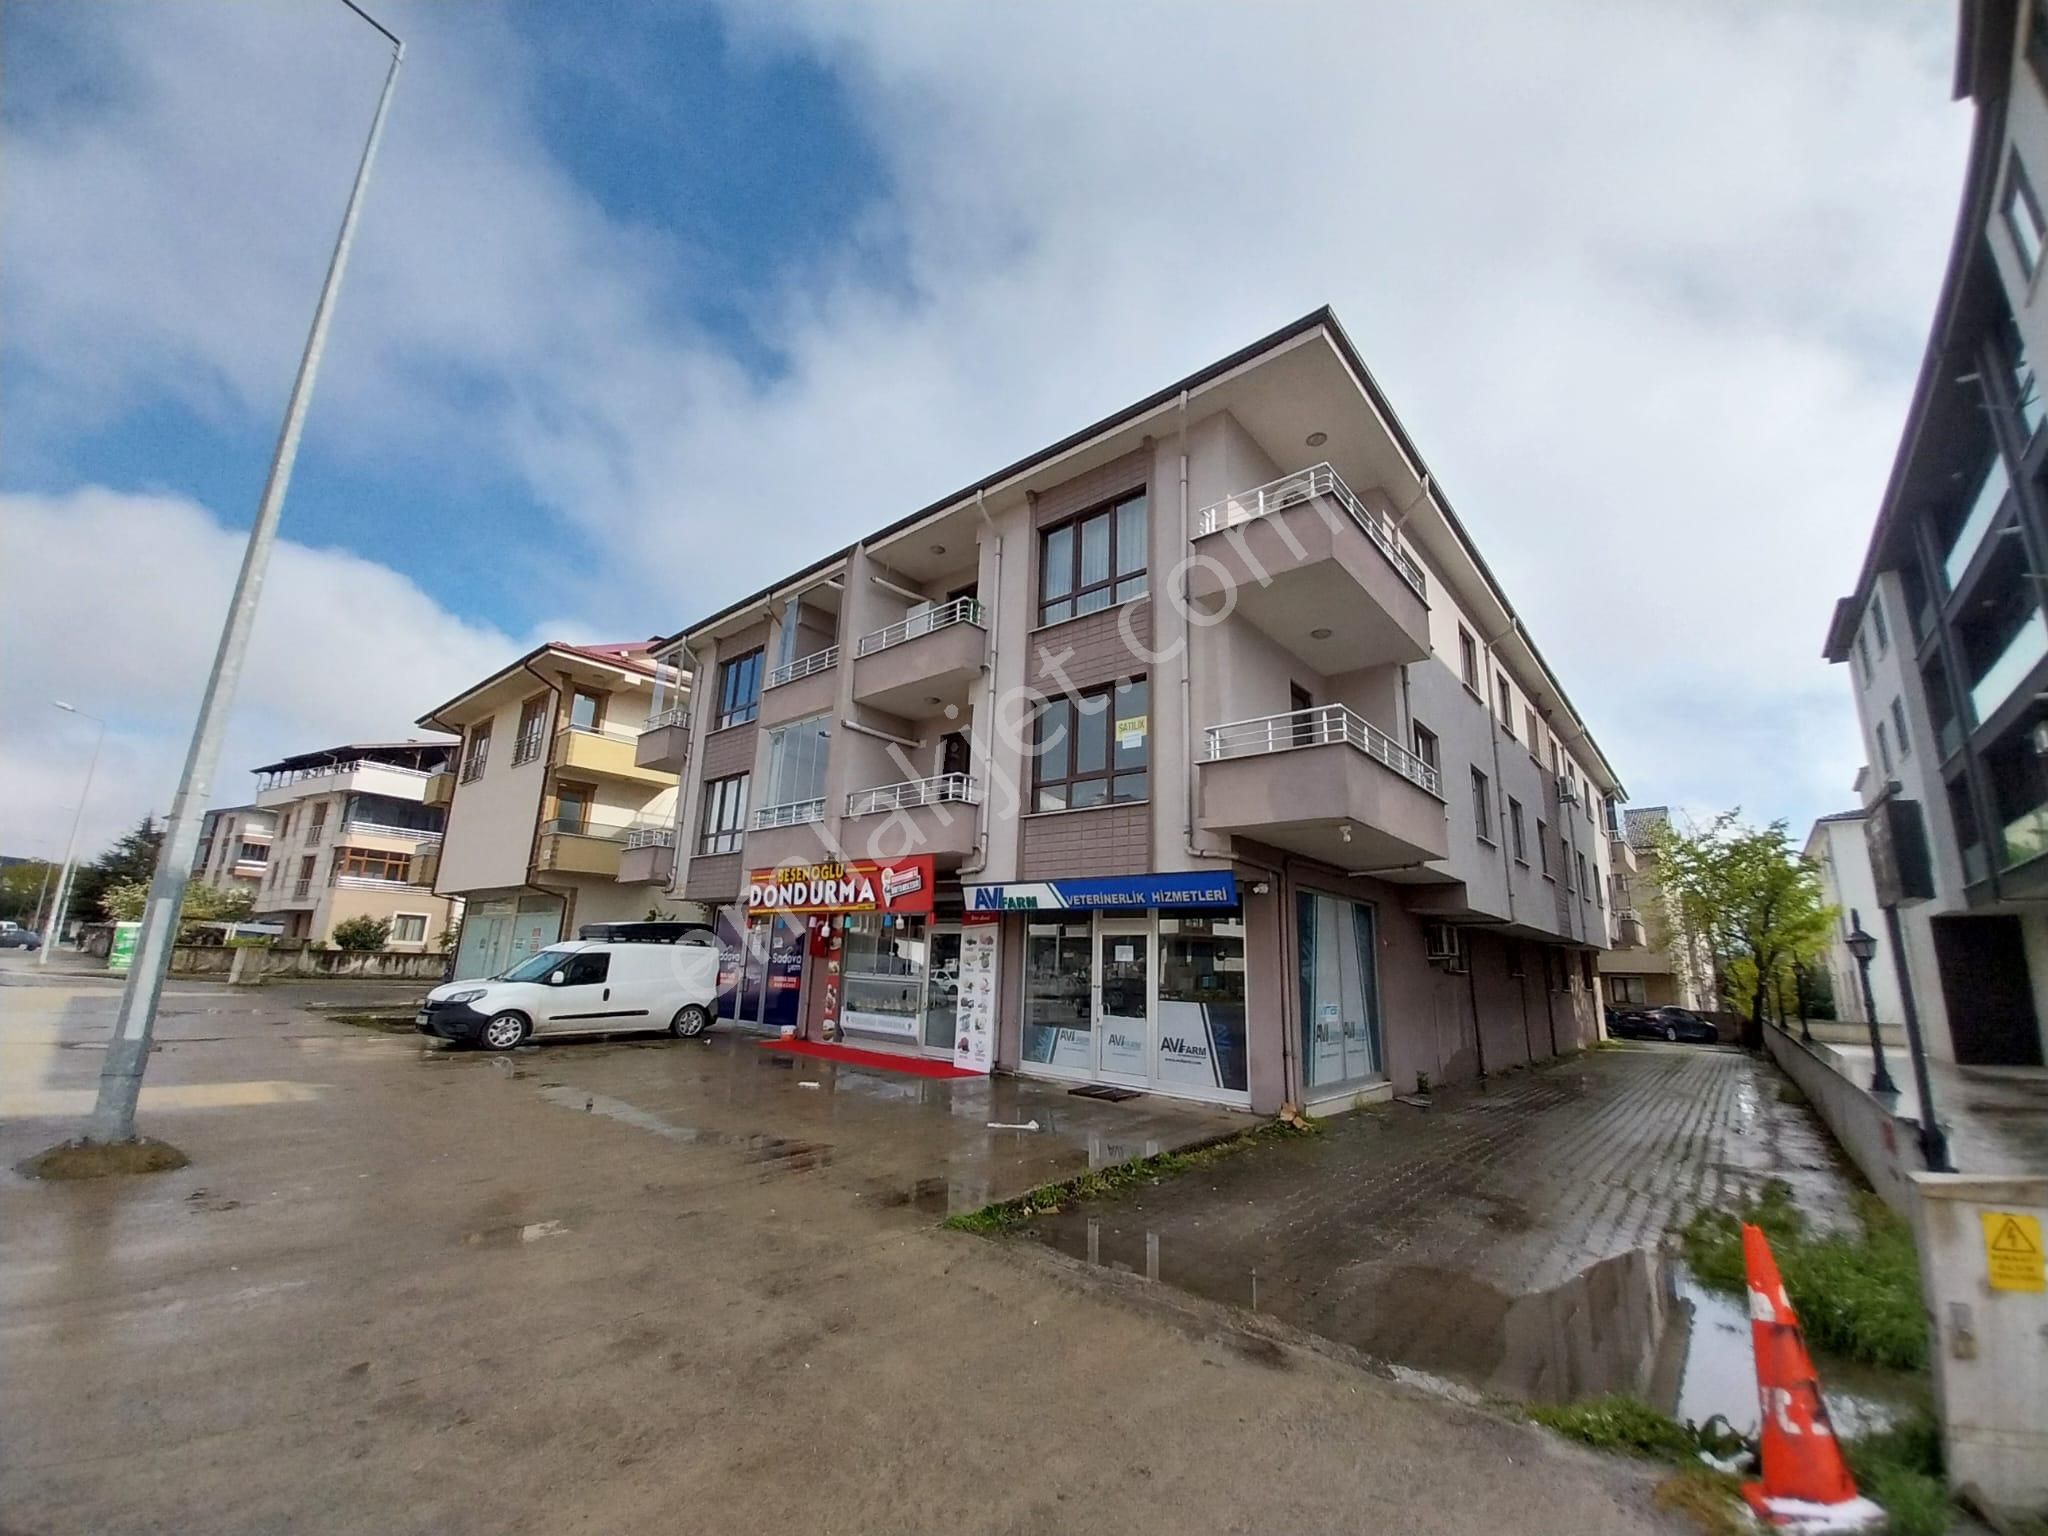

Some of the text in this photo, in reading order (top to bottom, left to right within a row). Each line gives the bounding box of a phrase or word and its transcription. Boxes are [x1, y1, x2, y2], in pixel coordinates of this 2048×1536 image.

[750, 878, 875, 907] DONDURMA
[1066, 891, 1146, 905] VETERİNERLİK
[1151, 887, 1228, 903] HİZMETLERİ
